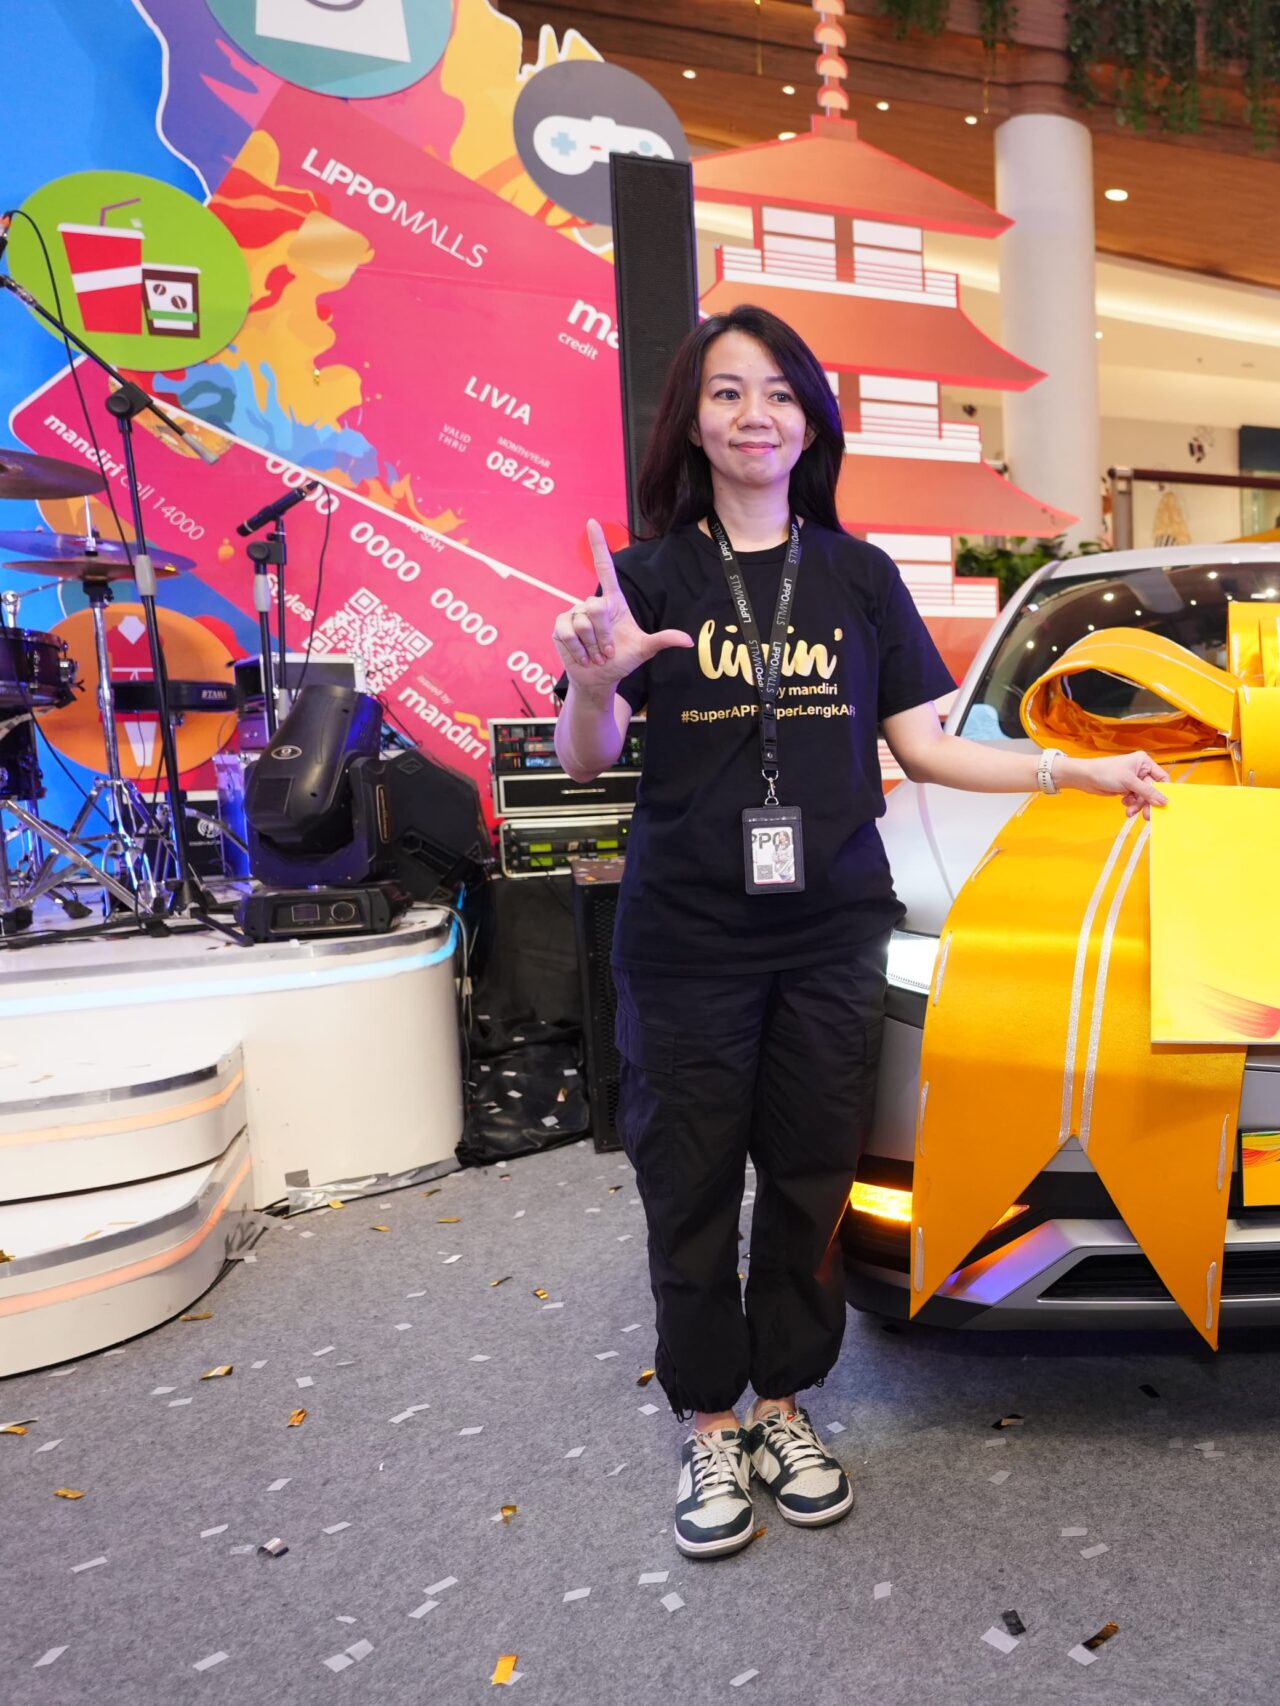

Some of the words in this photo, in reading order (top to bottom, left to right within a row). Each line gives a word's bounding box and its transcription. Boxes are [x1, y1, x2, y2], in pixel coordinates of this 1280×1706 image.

[301, 147, 488, 268] LIPPOMALLS
[557, 332, 600, 360] credit
[464, 376, 532, 425] LIVIA
[438, 432, 467, 453] THRU
[443, 423, 472, 443] VALID
[497, 436, 551, 469] MONTH/YEAR
[43, 414, 124, 477] mandiri
[152, 497, 205, 540] 14000
[486, 451, 555, 495] 08/29
[350, 522, 421, 581] 0000
[430, 588, 498, 646] 0000
[788, 682, 838, 696] mandiri
[398, 687, 487, 760] mandiri
